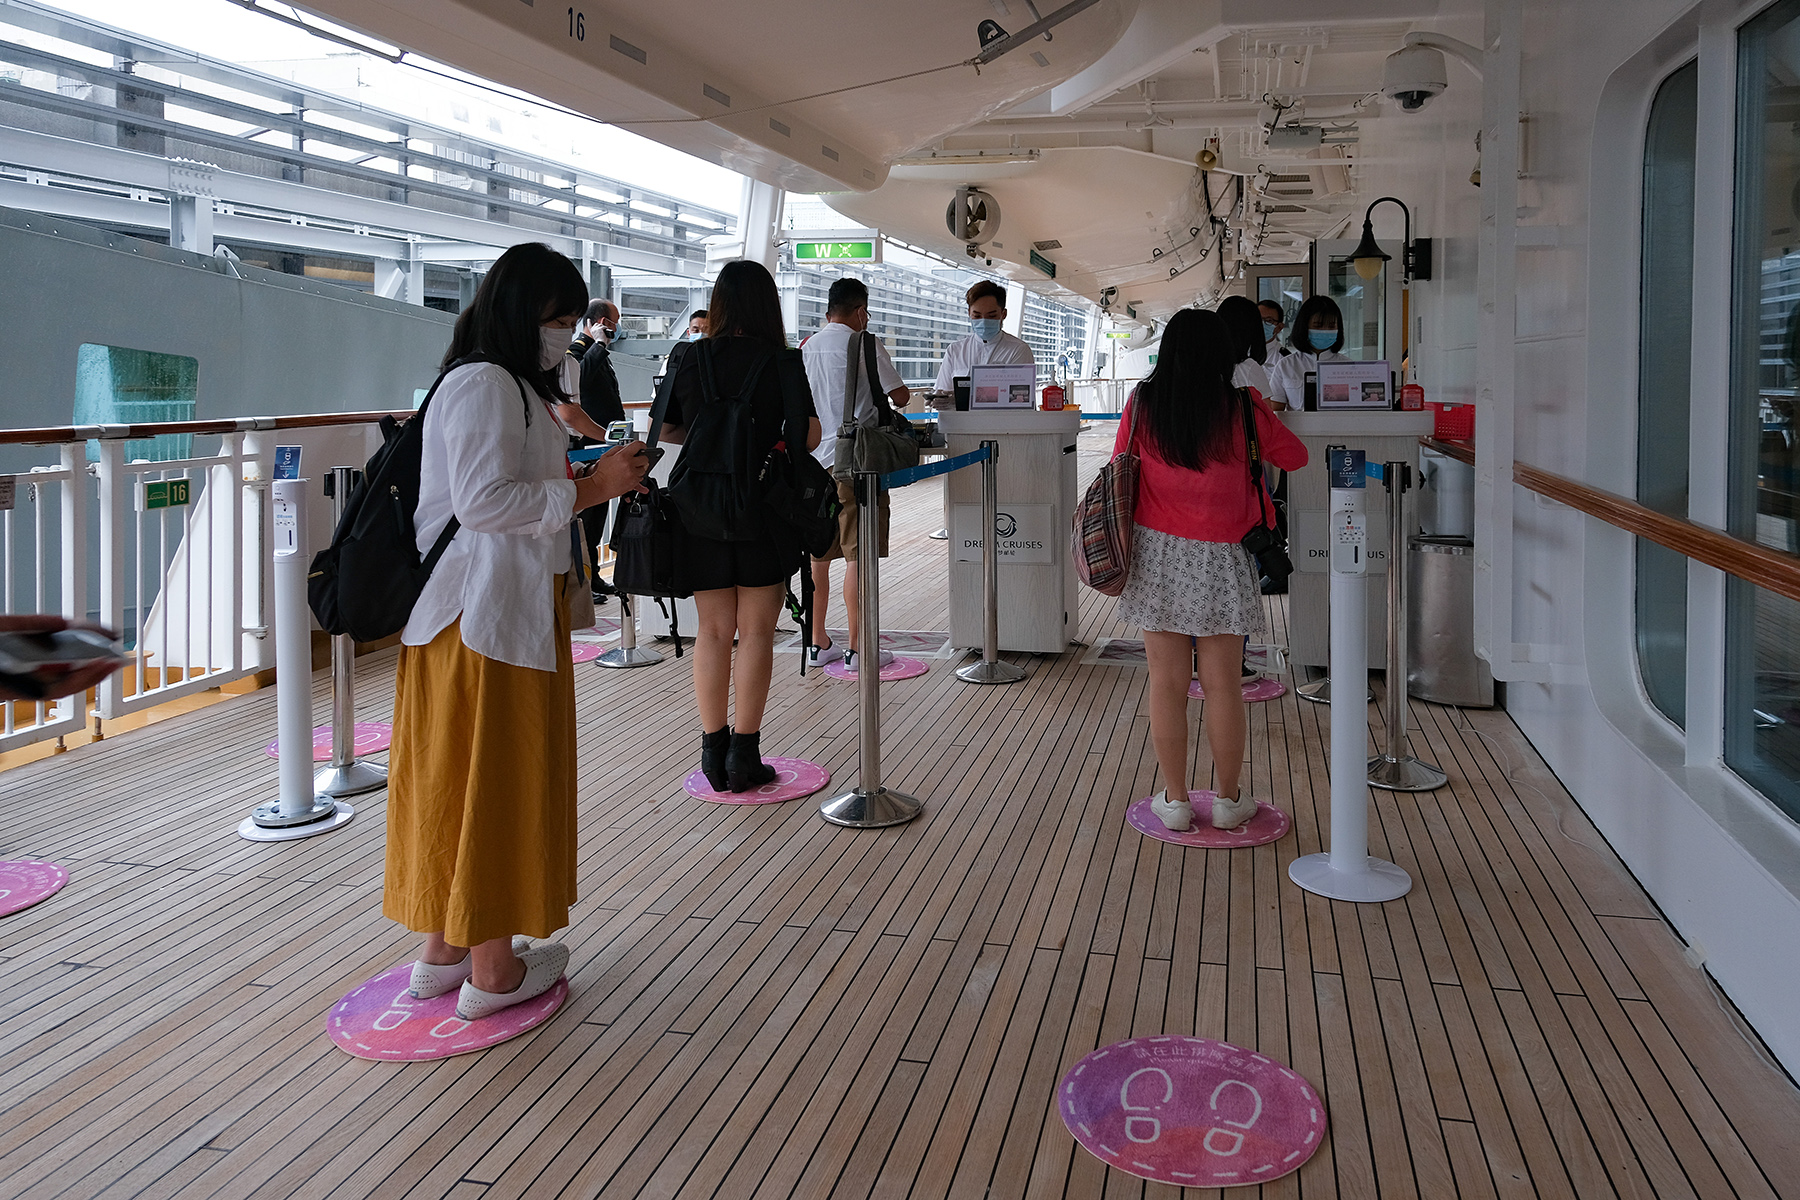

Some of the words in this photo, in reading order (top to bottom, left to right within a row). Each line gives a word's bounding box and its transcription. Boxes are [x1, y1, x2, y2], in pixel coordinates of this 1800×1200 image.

[567, 6, 585, 42] 16
[814, 243, 832, 258] W
[1250, 440, 1258, 460] Nikon
[172, 484, 187, 502] 16
[964, 539, 1001, 549] DRE
[1003, 540, 1043, 550] CRUISES
